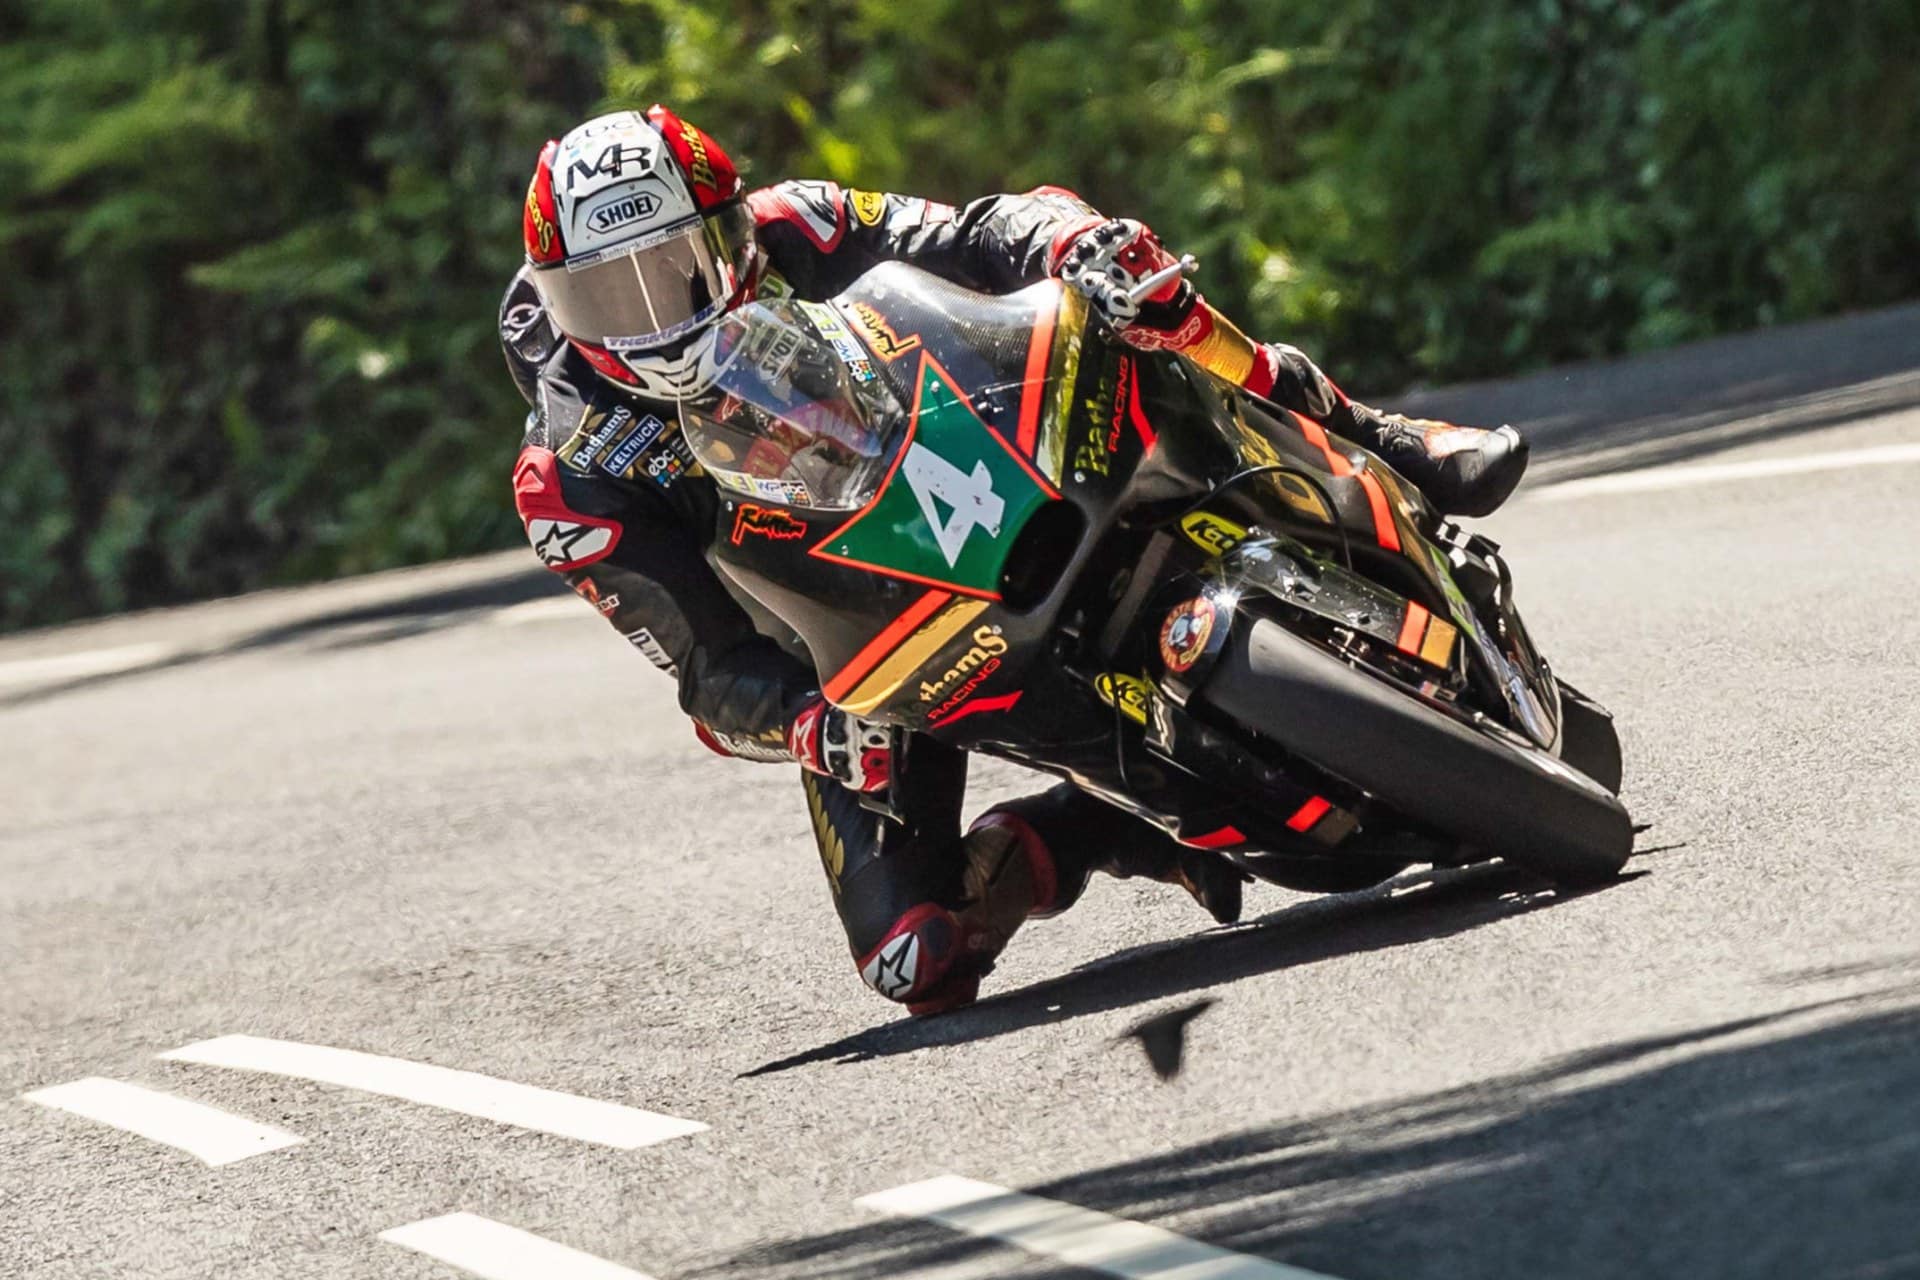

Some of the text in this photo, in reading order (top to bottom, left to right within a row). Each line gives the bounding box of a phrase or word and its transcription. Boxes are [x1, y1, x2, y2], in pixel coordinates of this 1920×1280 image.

[596, 195, 653, 229] SHOEI
[1108, 355, 1129, 452] RACING
[609, 421, 660, 475] KELTRUCK
[648, 449, 676, 477] ebc
[901, 441, 1005, 568] 4
[928, 657, 1002, 720] RACING
